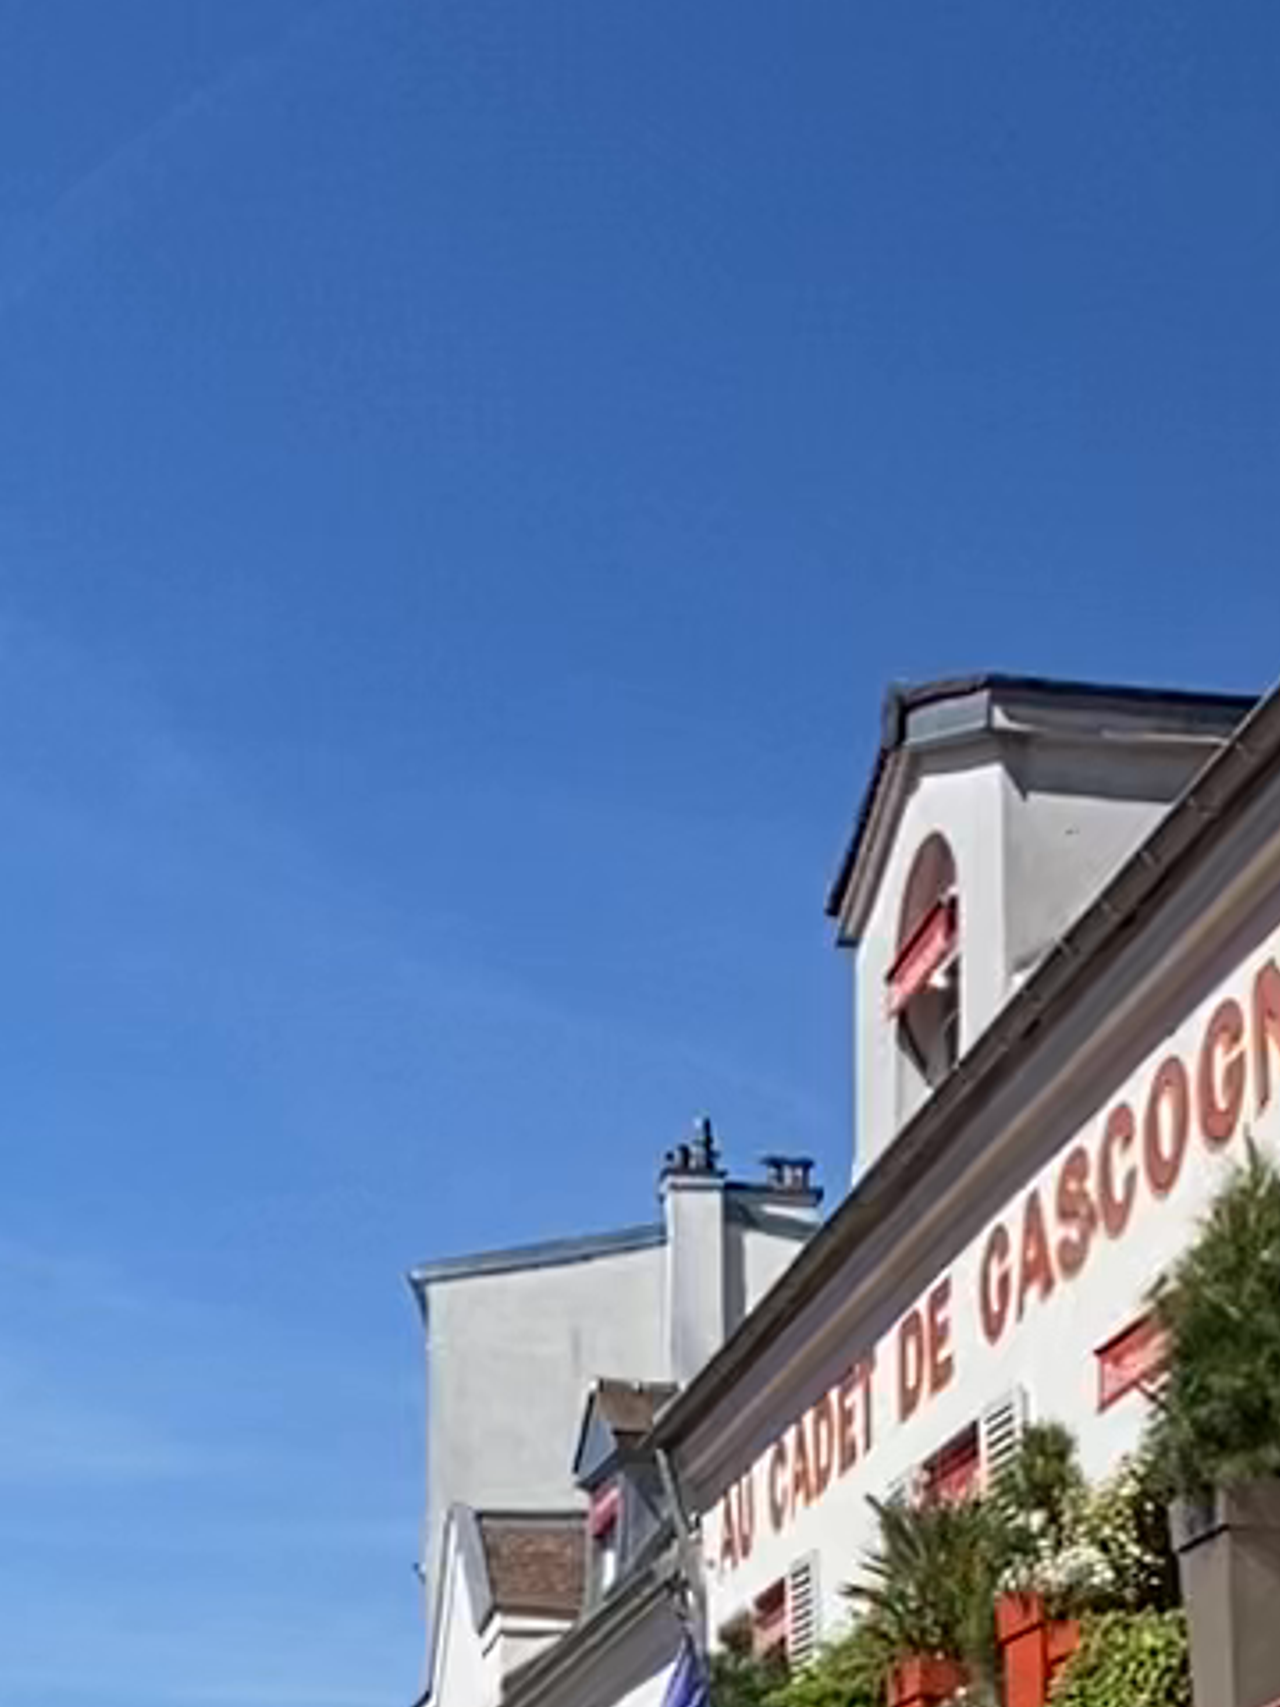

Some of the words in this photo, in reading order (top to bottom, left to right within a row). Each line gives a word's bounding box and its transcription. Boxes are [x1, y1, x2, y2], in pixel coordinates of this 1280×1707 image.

[722, 1476, 756, 1570] AU
[768, 1343, 877, 1533] CADET
[897, 1274, 954, 1424] DE
